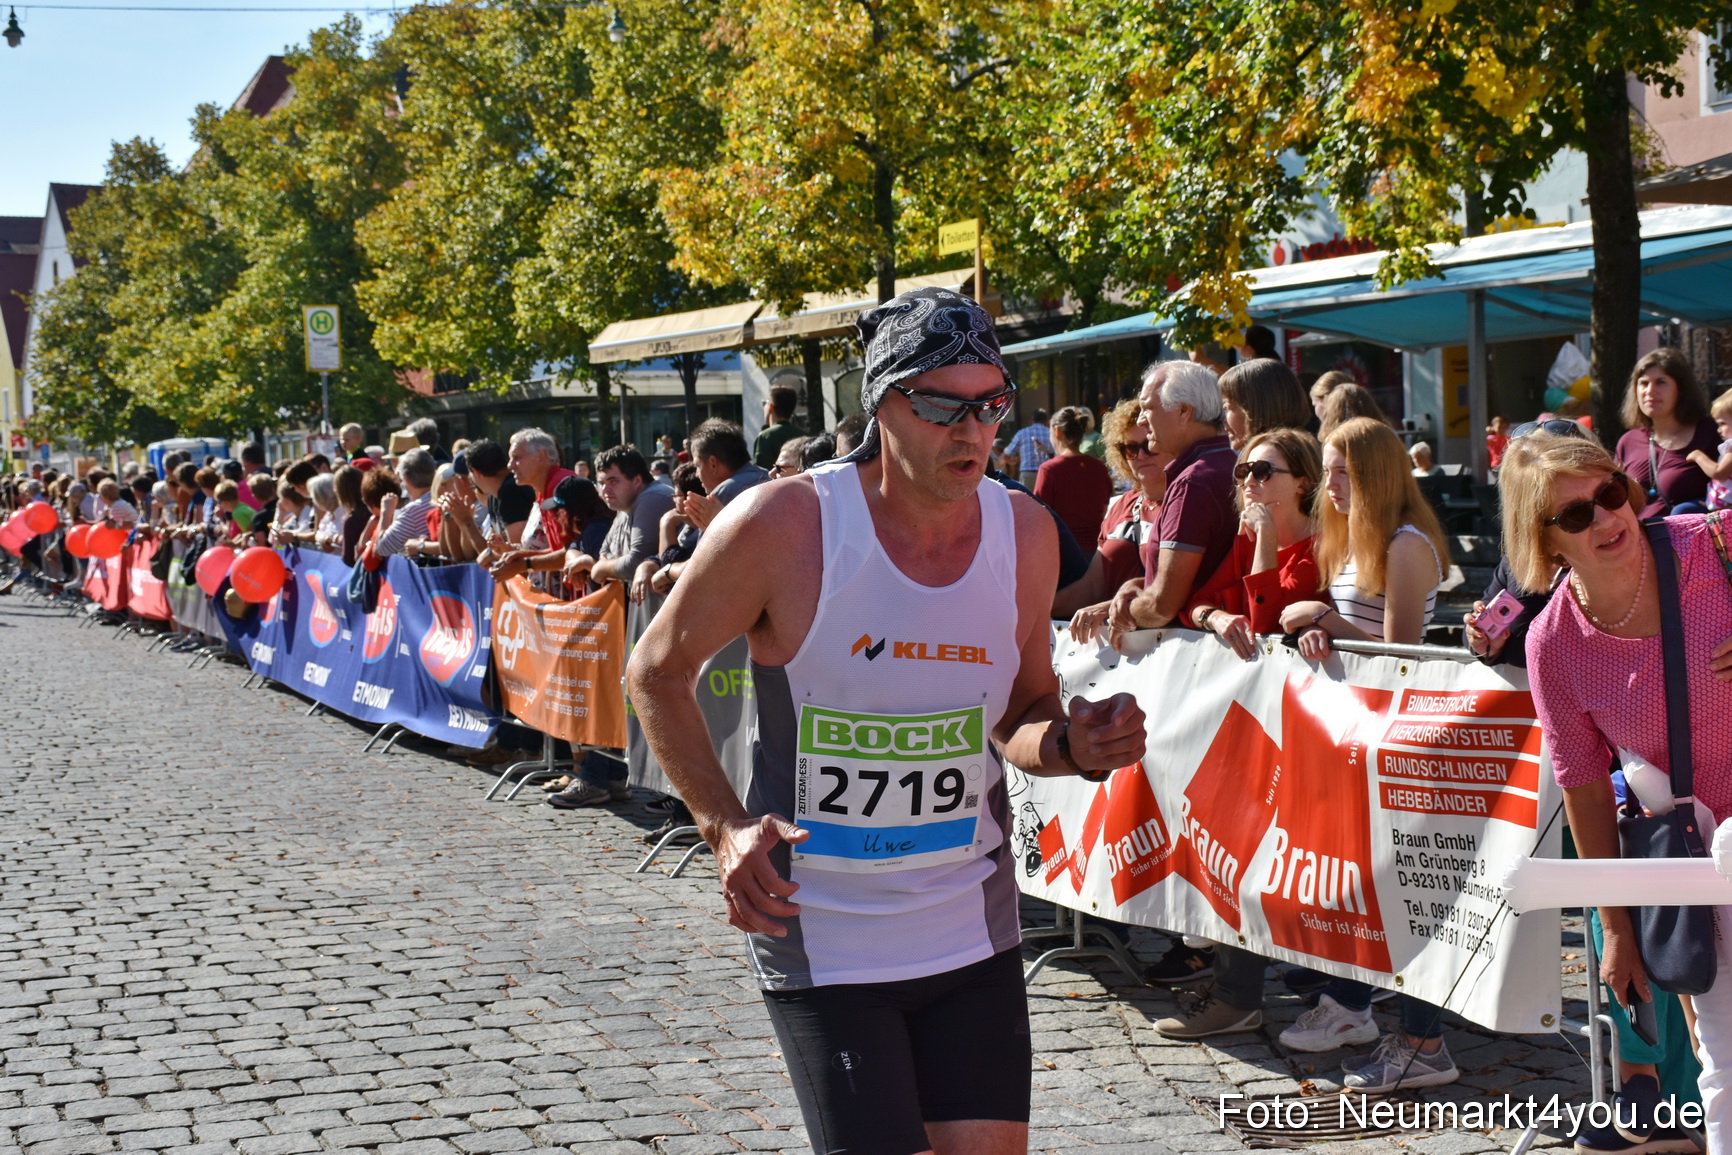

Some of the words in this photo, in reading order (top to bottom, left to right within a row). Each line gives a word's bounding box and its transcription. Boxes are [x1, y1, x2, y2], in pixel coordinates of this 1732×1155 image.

[946, 231, 976, 246] Toiletten
[892, 641, 994, 666] KLEBL
[574, 706, 589, 718] 897
[813, 714, 972, 756] BOCK
[1391, 724, 1515, 748] VERZURRSYSTEME
[1384, 755, 1507, 781] RUNDSCHLINGEN
[818, 766, 966, 818] 2719
[1265, 788, 1276, 806] Seit
[1271, 764, 1283, 788] 1929
[1387, 788, 1488, 813] HEBEBÄNDER
[863, 833, 917, 854] Uwe
[1105, 817, 1166, 881] Braun
[1178, 797, 1239, 895] Braun
[1392, 828, 1430, 849] Braun
[1434, 832, 1477, 852] GmbH
[1129, 859, 1151, 878] Sicher
[1150, 854, 1160, 866] ist
[1260, 826, 1368, 916] Braun
[1395, 850, 1416, 868] Am
[1418, 852, 1478, 878] Grünberg
[1480, 859, 1486, 876] 8
[1213, 882, 1222, 898] ist
[1398, 870, 1450, 891] D-92318
[1403, 899, 1429, 917] Tel.
[1430, 902, 1460, 925] 09181
[1300, 911, 1333, 934] Sicher
[1336, 920, 1350, 936] ist
[1352, 922, 1386, 944] sicher
[1408, 920, 1431, 939] Fax
[1433, 923, 1459, 947] 09181
[840, 1051, 852, 1070] ZEN
